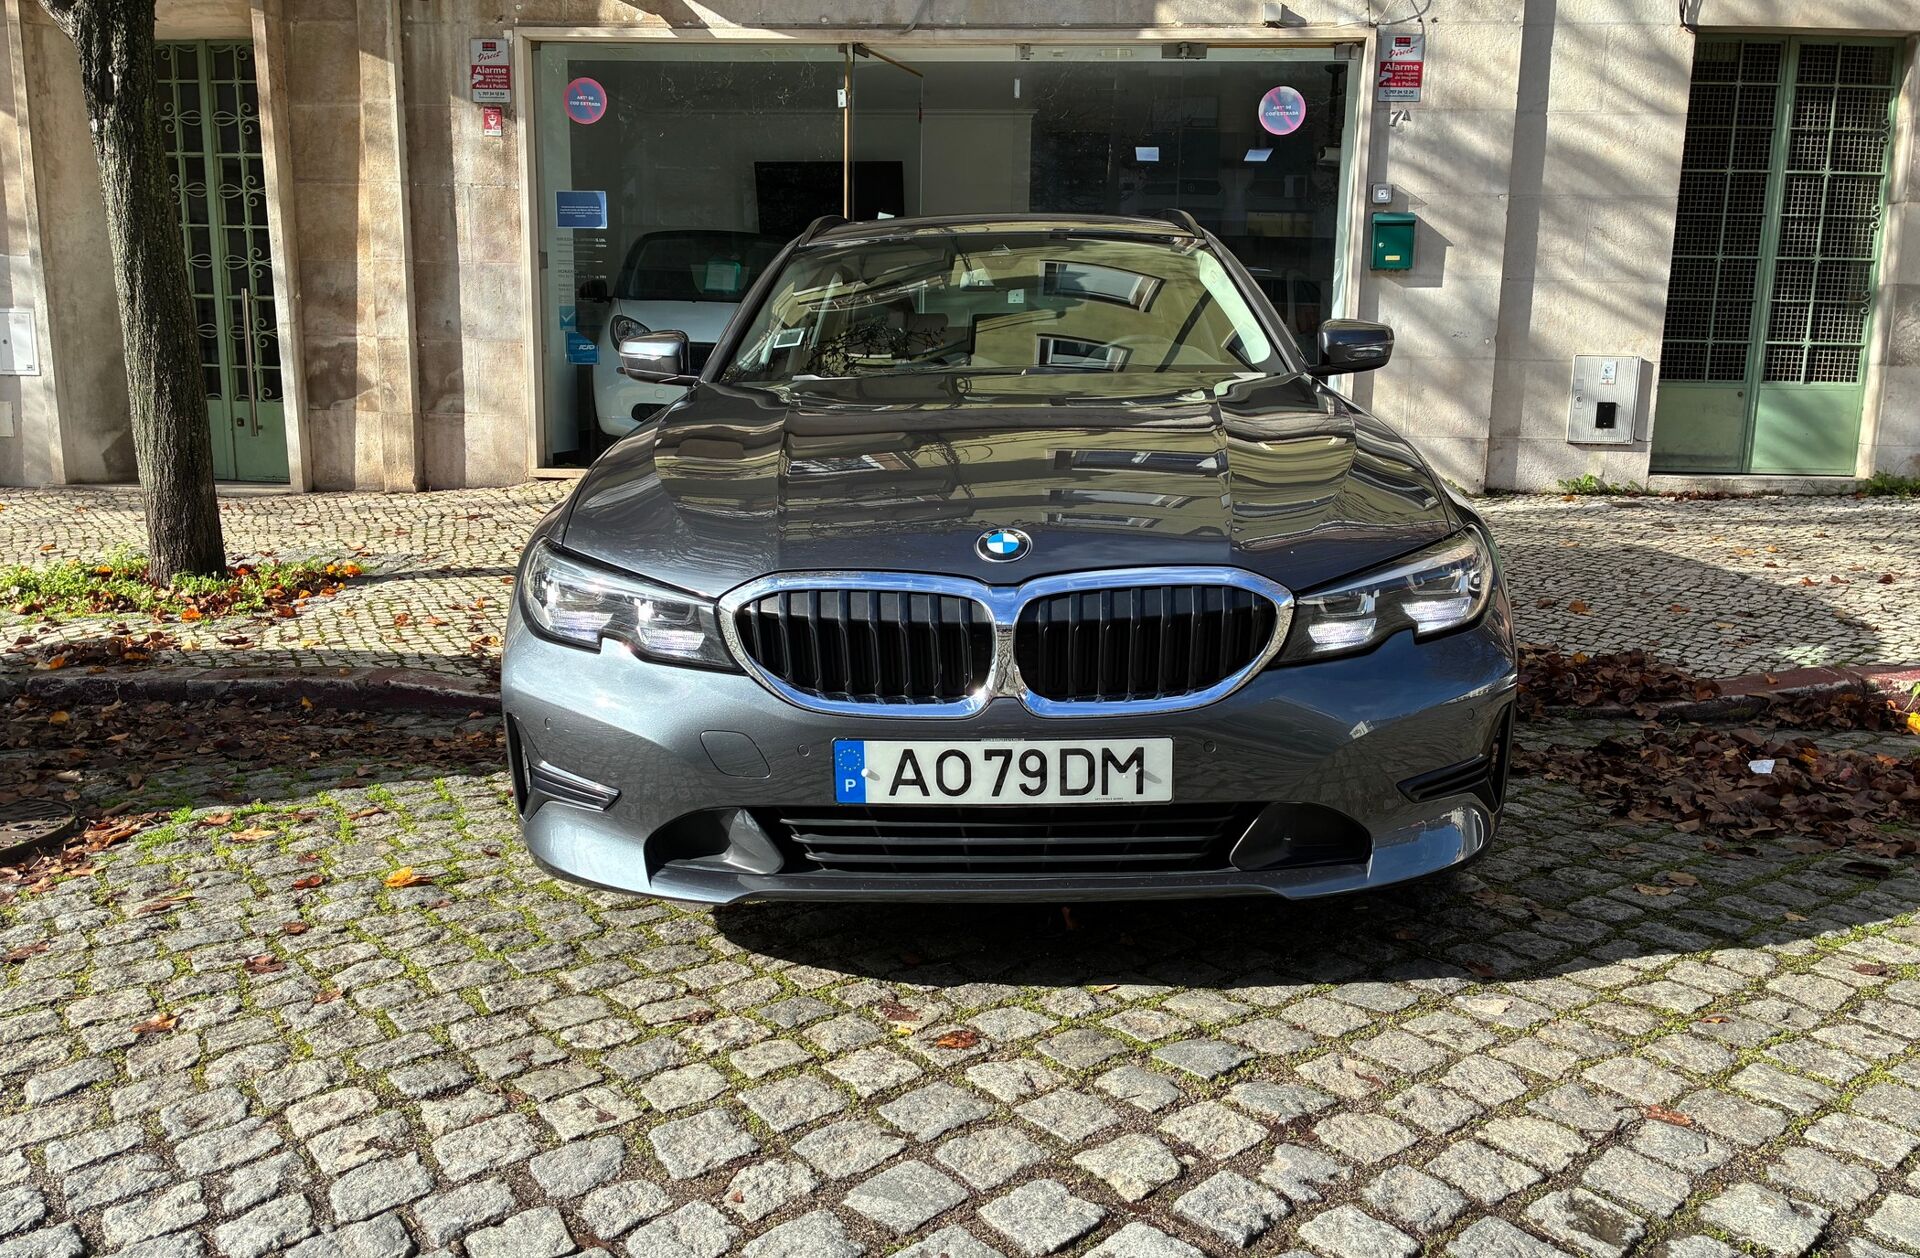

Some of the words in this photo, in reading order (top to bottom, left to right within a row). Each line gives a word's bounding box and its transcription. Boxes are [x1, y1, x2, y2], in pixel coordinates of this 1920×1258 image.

[477, 50, 503, 62] Direct
[1388, 46, 1417, 58] Direct
[475, 66, 507, 74] Alarme
[1384, 63, 1420, 71] Alarme
[1388, 109, 1412, 127] 7A
[845, 778, 857, 793] P
